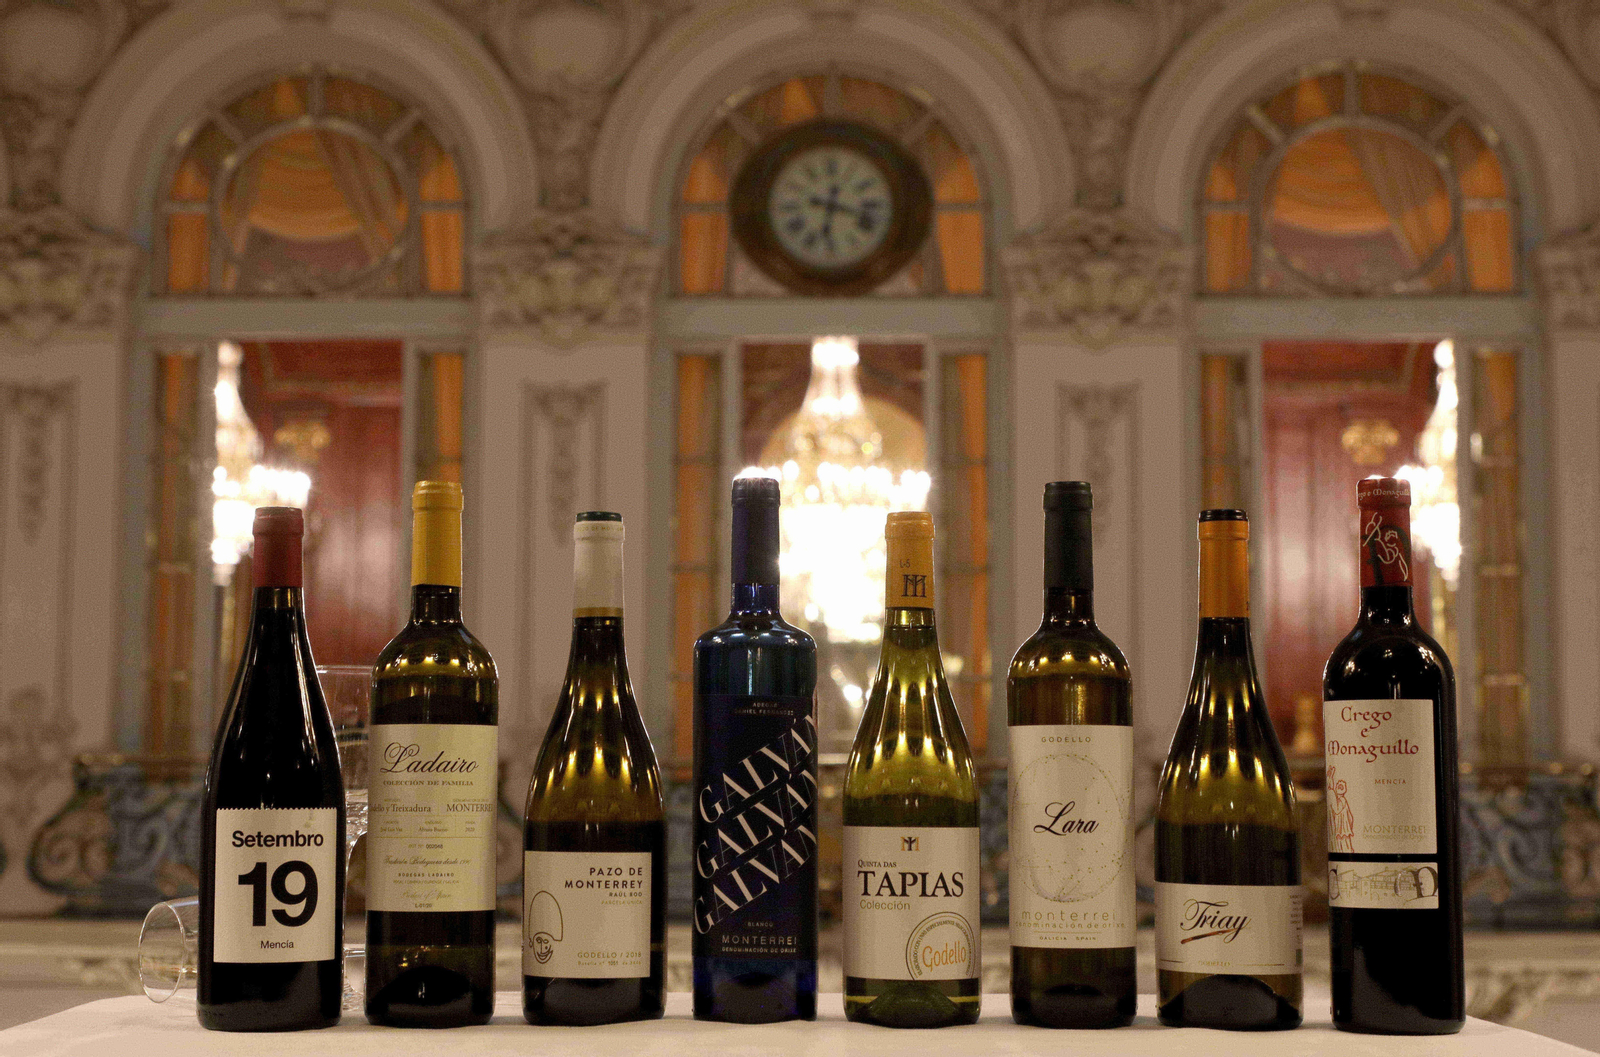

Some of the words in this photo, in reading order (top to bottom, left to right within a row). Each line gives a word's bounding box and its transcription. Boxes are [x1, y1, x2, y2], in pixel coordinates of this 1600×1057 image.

[1341, 705, 1392, 729] Crego
[1360, 728, 1369, 738] e
[1328, 739, 1419, 763] Monaguillo
[380, 742, 480, 773] Ladairo
[391, 803, 431, 812] Treixadura
[1033, 801, 1100, 836] Lara
[1363, 824, 1427, 834] MONTERREI
[232, 830, 324, 847] Setembro
[589, 867, 622, 876] PAZO
[629, 867, 643, 875] DE
[565, 880, 643, 888] MONTERREY
[857, 870, 964, 897] TAPIAS
[238, 860, 318, 927] 19
[860, 899, 911, 910] Colección
[1021, 909, 1116, 921] monterrei
[1087, 921, 1099, 929] de
[1180, 899, 1252, 944] Triay
[260, 940, 295, 949] Mencía
[722, 934, 797, 945] MONTERREI
[577, 951, 618, 959] GODELLO
[922, 940, 968, 973] Godello
